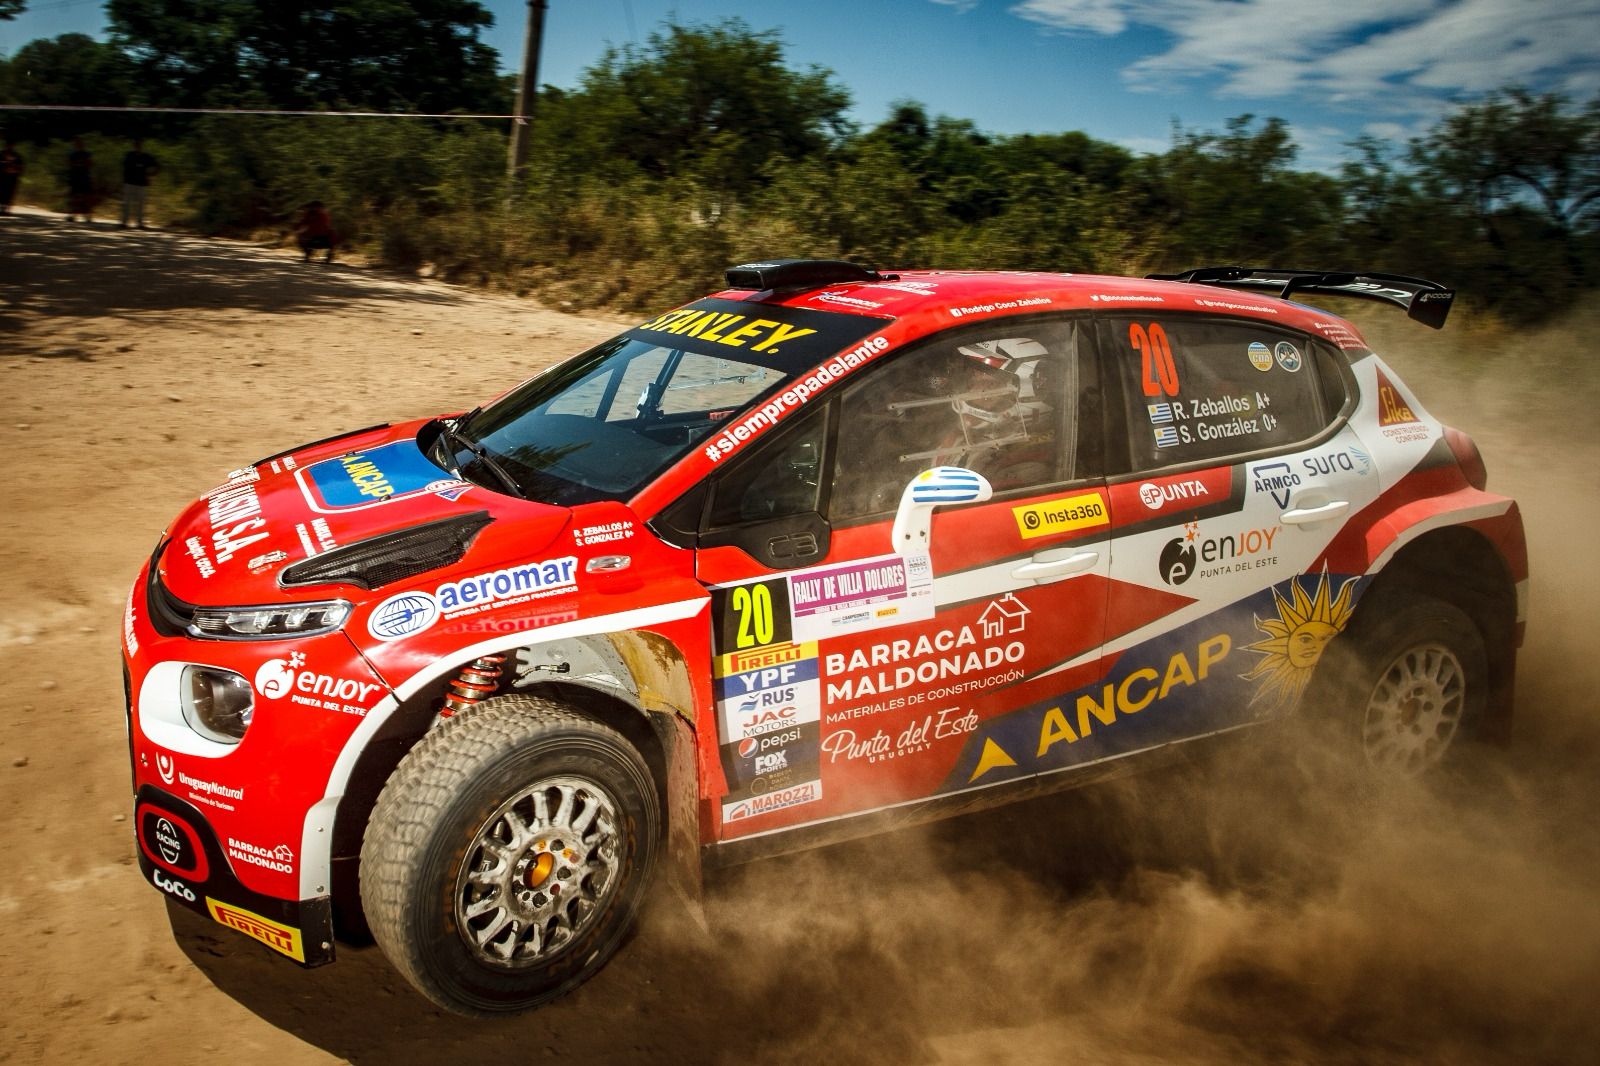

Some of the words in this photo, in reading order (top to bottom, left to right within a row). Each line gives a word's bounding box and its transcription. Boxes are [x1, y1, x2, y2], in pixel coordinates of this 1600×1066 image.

[961, 303, 995, 315] Rodrigo
[995, 301, 1017, 309] Coco
[1017, 297, 1051, 306] Zeballos
[1129, 322, 1179, 397] 20
[705, 335, 889, 461] #siemprepadelante
[1172, 402, 1190, 420] R.
[1190, 395, 1250, 418] Zeballos
[1255, 391, 1270, 410] A+
[1380, 386, 1414, 424] Sika
[1180, 424, 1196, 443] S.
[1197, 418, 1259, 440] González
[1302, 452, 1354, 476] sura
[346, 459, 394, 499] ANCAP
[1254, 473, 1301, 492] ARMCO
[1150, 480, 1208, 504] PUNTA
[1043, 503, 1102, 525] Insta360
[573, 529, 582, 538] R.
[583, 522, 623, 536] ZEBALLOS
[622, 521, 633, 529] A+
[576, 538, 584, 546] S.
[1200, 565, 1231, 579] PUNTA
[1235, 560, 1252, 572] DEL
[1255, 556, 1278, 568] ESTE
[440, 560, 575, 609] aeromar
[793, 579, 820, 604] RALLY
[823, 576, 836, 599] DE
[838, 571, 863, 597] VILLA
[864, 564, 905, 591] DOLORES
[444, 609, 478, 620] EMPRESA
[480, 606, 492, 614] DE
[492, 598, 530, 611] SERVICIOS
[530, 586, 578, 600] FINANCIEROS
[733, 583, 774, 648] 20
[730, 643, 801, 672] PIRELLI
[825, 625, 976, 676] BARRACA
[740, 664, 796, 691] YPF
[826, 641, 1025, 704] MALDONADO
[291, 695, 320, 708] PUNTA
[323, 702, 340, 711] DEL
[342, 705, 366, 717] ESTE
[762, 687, 795, 707] RUS
[826, 700, 905, 724] MATERIALES
[908, 693, 925, 706] DE
[927, 669, 1025, 700] CONSTRUCCIÓN
[1036, 633, 1232, 758] ANCAP
[743, 706, 796, 728] JAC
[743, 718, 796, 737] MOTORS
[760, 727, 801, 751] pepsi
[821, 729, 891, 763] Punta
[897, 715, 932, 749] del
[935, 706, 978, 739] Este
[755, 749, 787, 770] FOX
[869, 743, 932, 763] URUGUAY
[755, 762, 787, 776] SPORTS
[179, 772, 244, 800] UruguayNatural
[752, 784, 814, 810] MAROZZI
[156, 831, 180, 851] RACING
[228, 838, 273, 860] BARRACA
[229, 849, 293, 874] MALDONADO
[215, 906, 293, 952] PIRELLI
